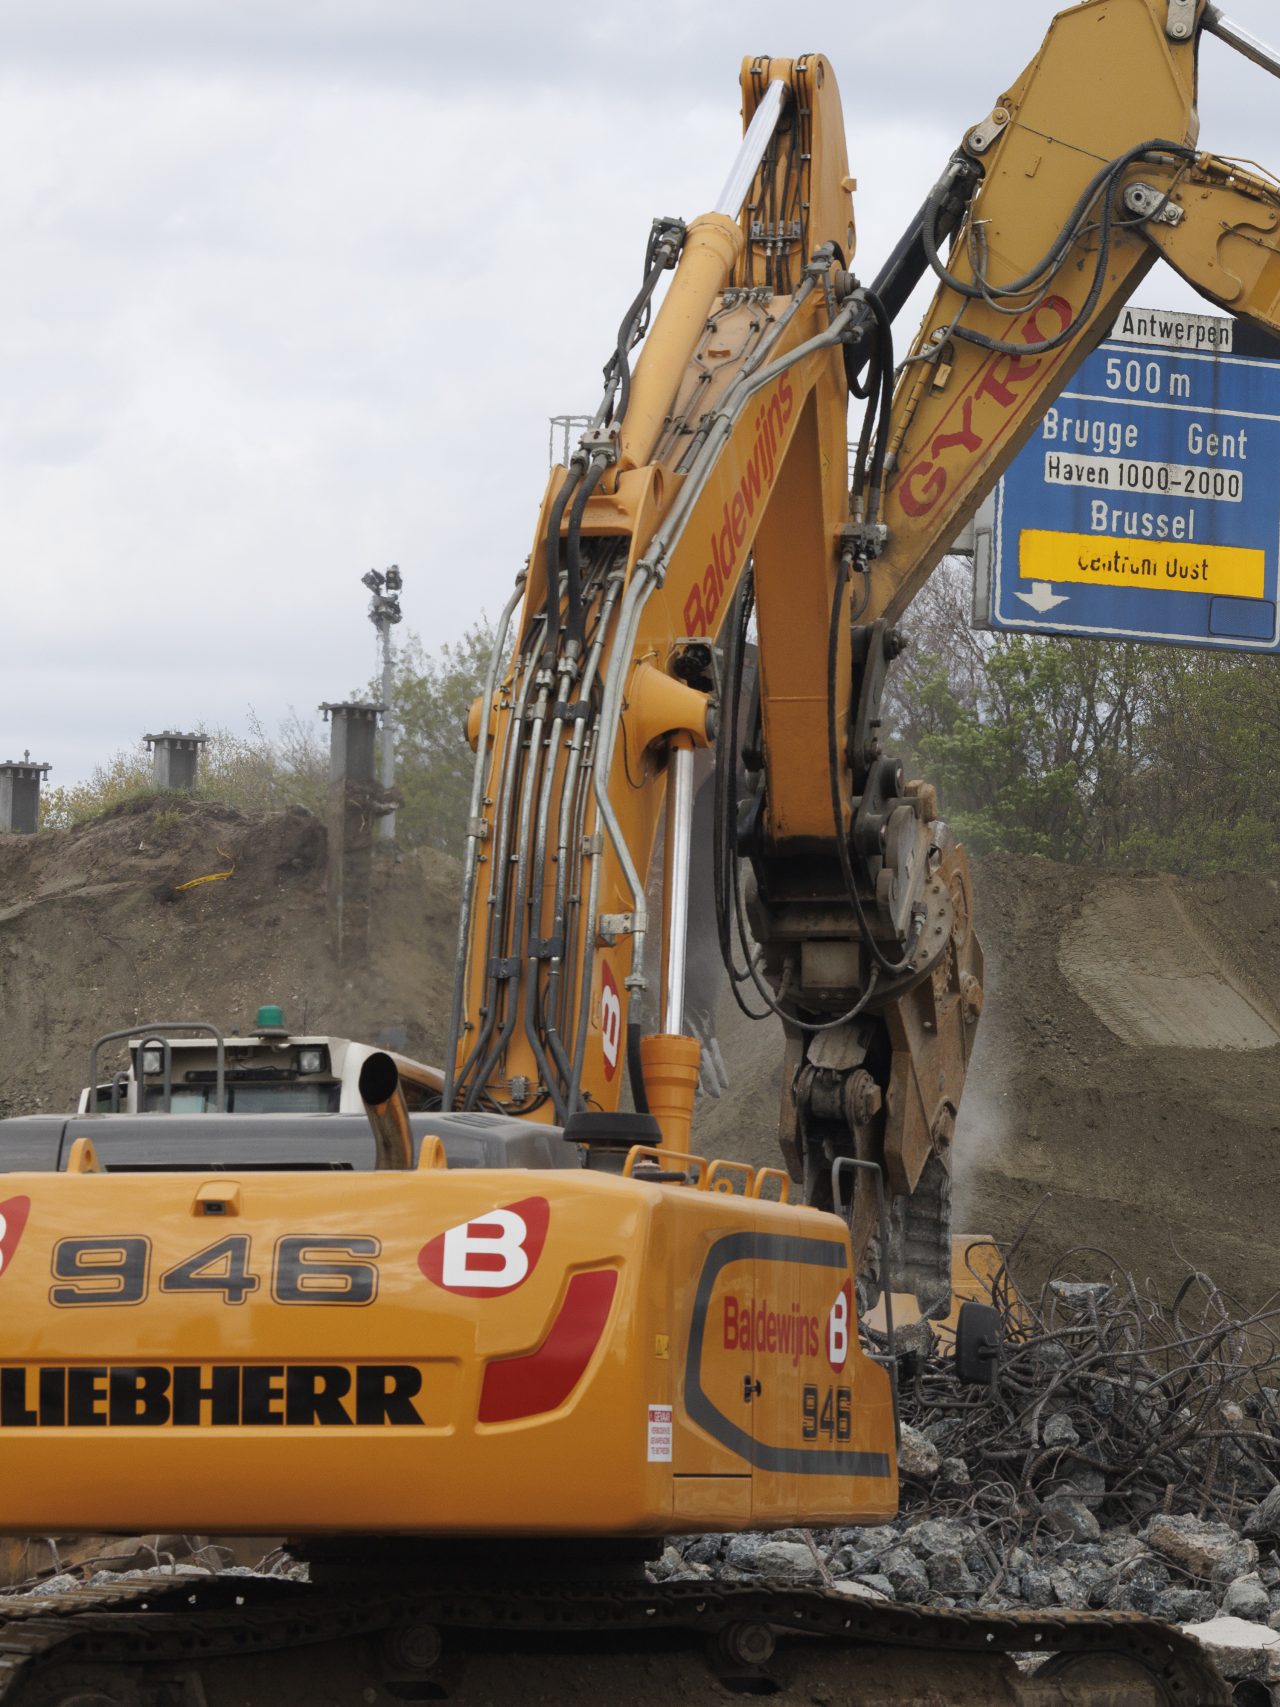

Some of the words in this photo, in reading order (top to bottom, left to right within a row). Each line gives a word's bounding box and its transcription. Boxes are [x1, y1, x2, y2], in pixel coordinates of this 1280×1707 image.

[1122, 311, 1230, 348] Antwerpen
[899, 295, 1073, 518] GYRO
[1105, 358, 1161, 394] 500
[1169, 373, 1190, 398] m
[1042, 407, 1139, 454] Brugge
[1188, 423, 1248, 460] Gent
[683, 368, 793, 638] Baldewijns
[1048, 456, 1109, 485] Haven
[1118, 463, 1240, 498] 1000-2000
[1090, 500, 1195, 540] Brussel
[48, 1233, 382, 1308] 946
[442, 1208, 529, 1288] B
[723, 1296, 820, 1368] Baldewijns
[829, 1291, 848, 1364] B
[0, 1366, 425, 1427] LIEBHERR
[802, 1384, 852, 1443] 946
